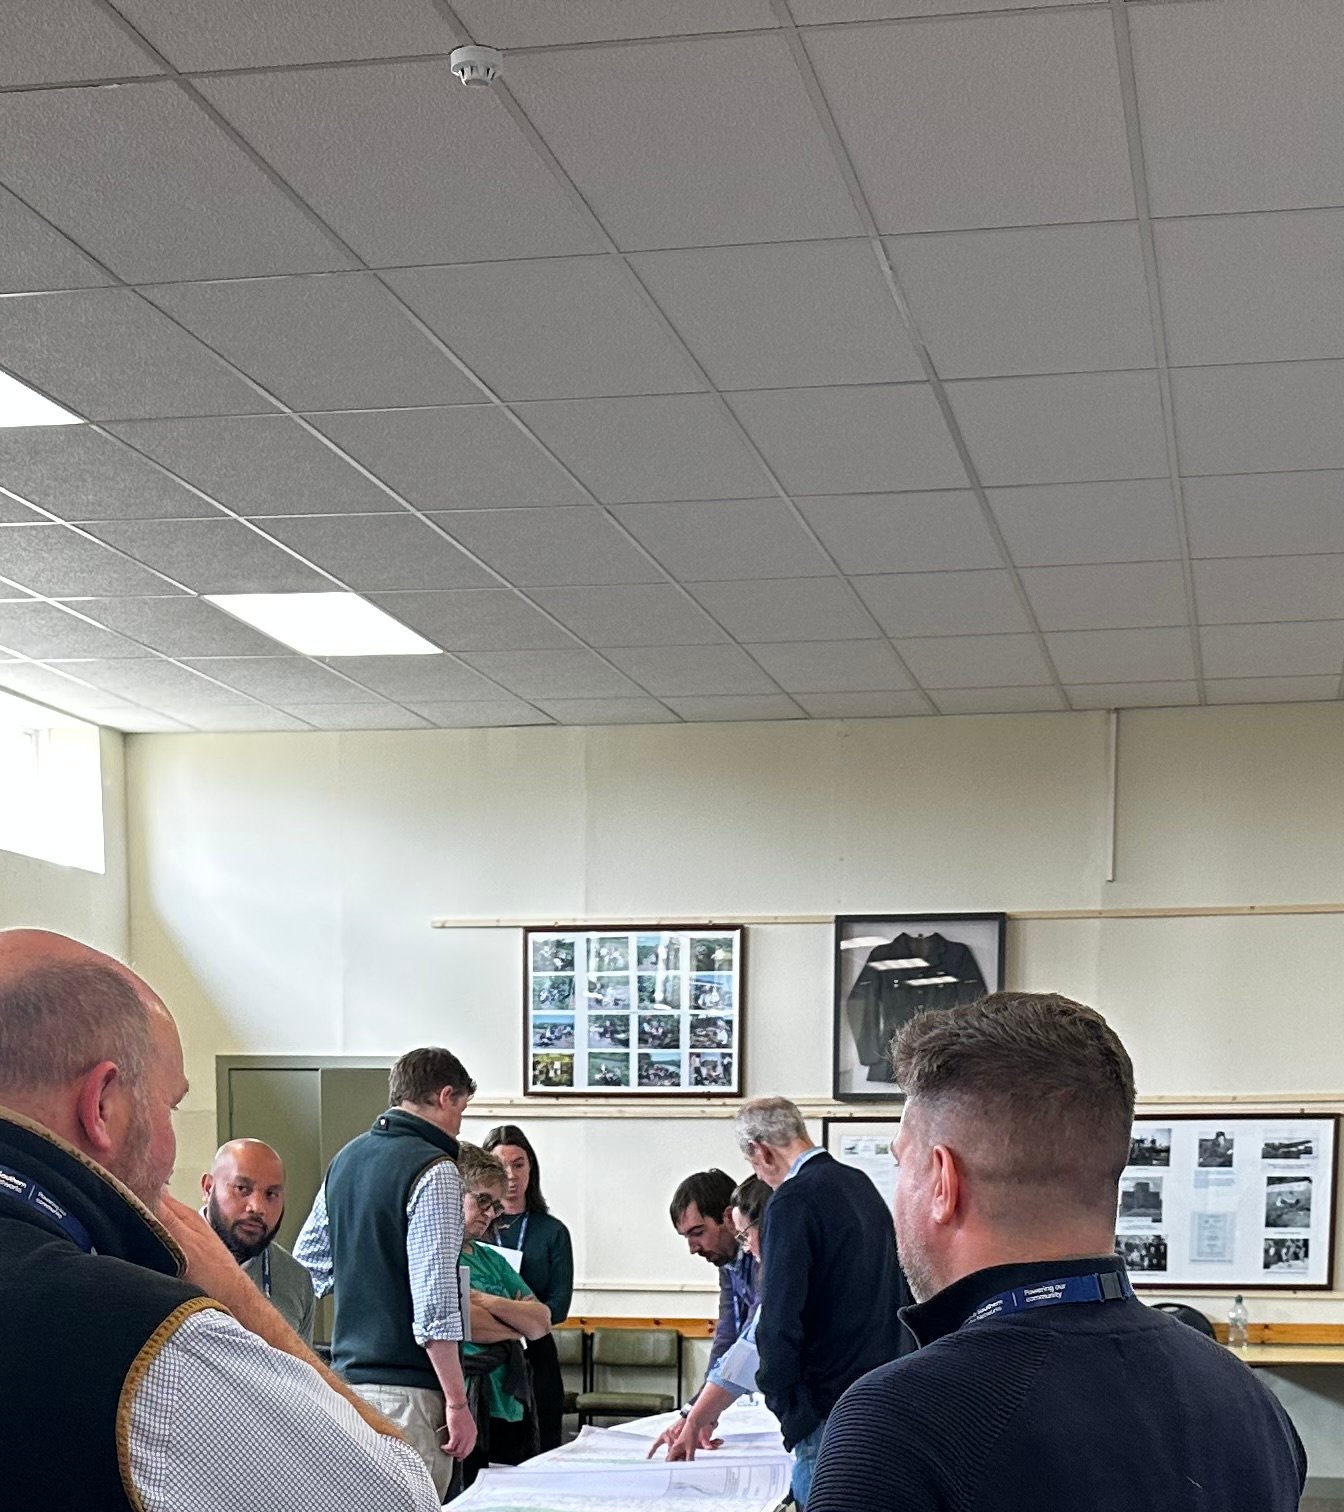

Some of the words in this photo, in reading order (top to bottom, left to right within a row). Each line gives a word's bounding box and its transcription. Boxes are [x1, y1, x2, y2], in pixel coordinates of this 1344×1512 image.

[1023, 1285, 1053, 1297] Powering
[1054, 1283, 1067, 1291] our
[1025, 1291, 1063, 1303] community
